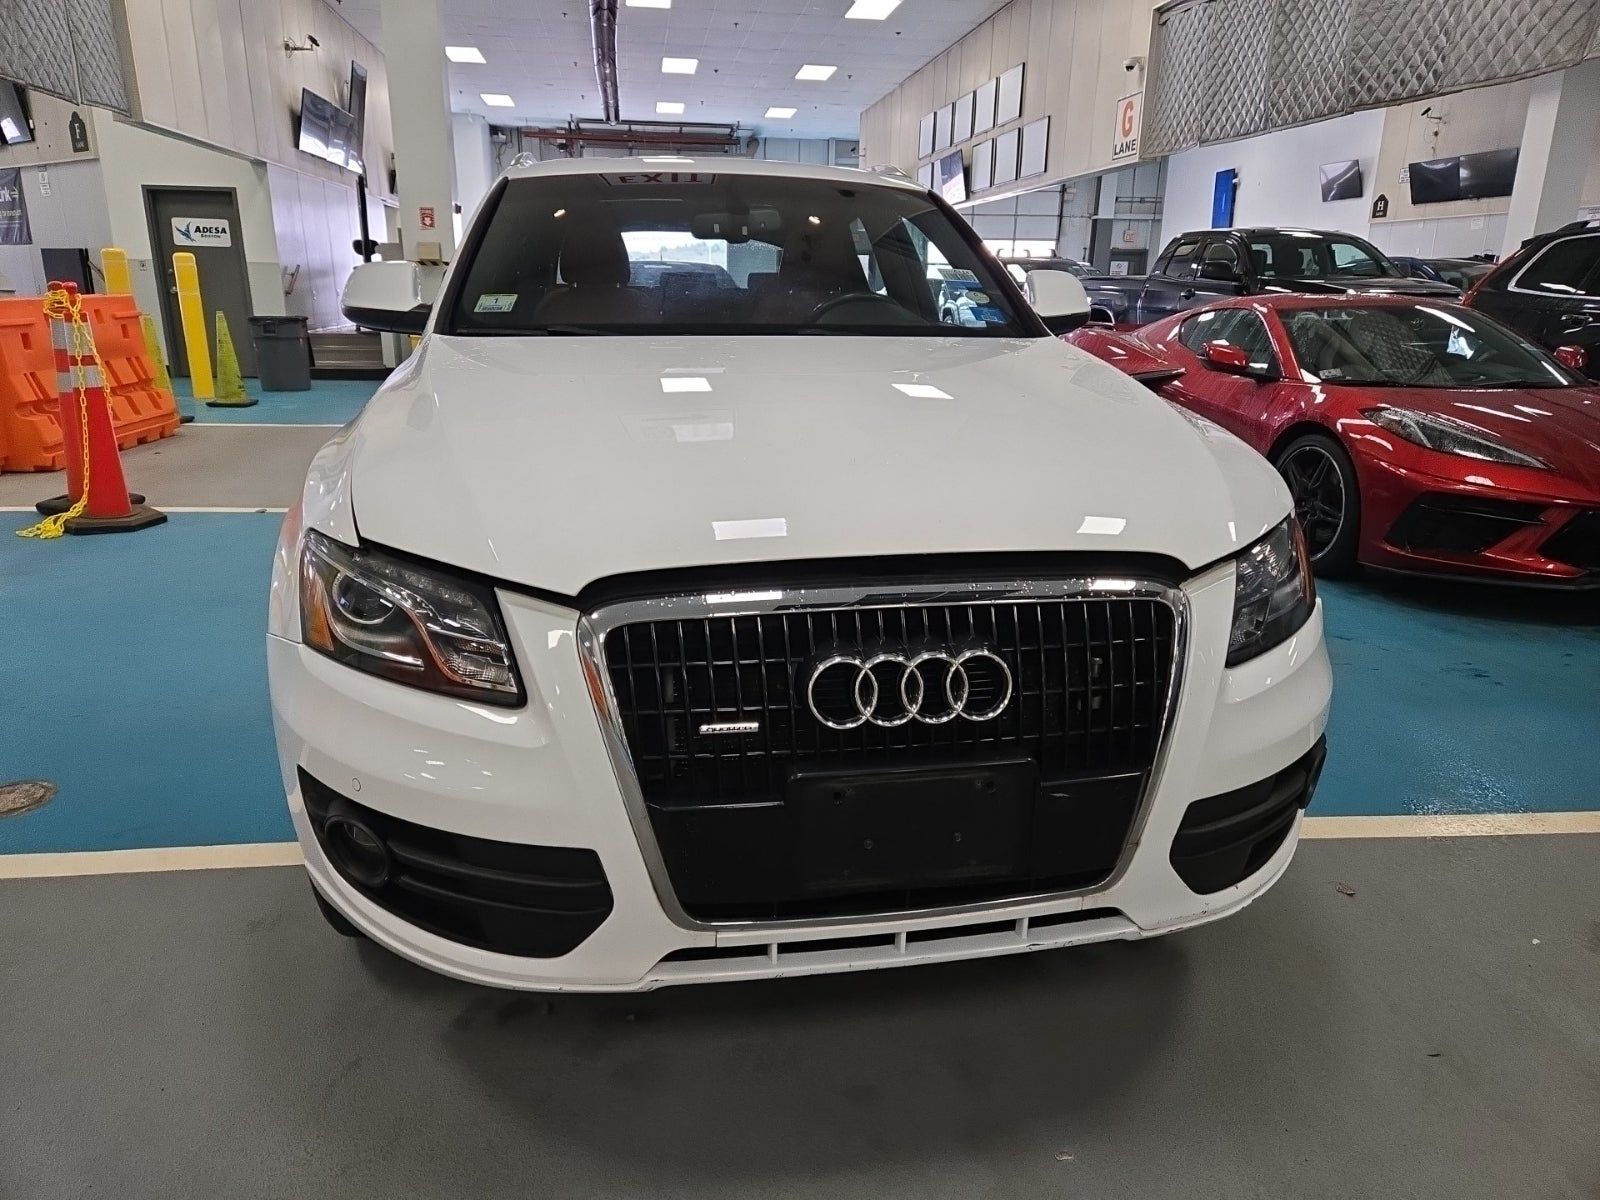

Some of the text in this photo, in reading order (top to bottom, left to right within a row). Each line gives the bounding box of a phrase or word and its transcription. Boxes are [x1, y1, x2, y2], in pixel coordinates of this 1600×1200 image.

[1122, 101, 1133, 137] G
[74, 123, 80, 138] F
[1114, 139, 1136, 156] LANE
[1377, 201, 1384, 210] H
[194, 225, 227, 234] ADESA
